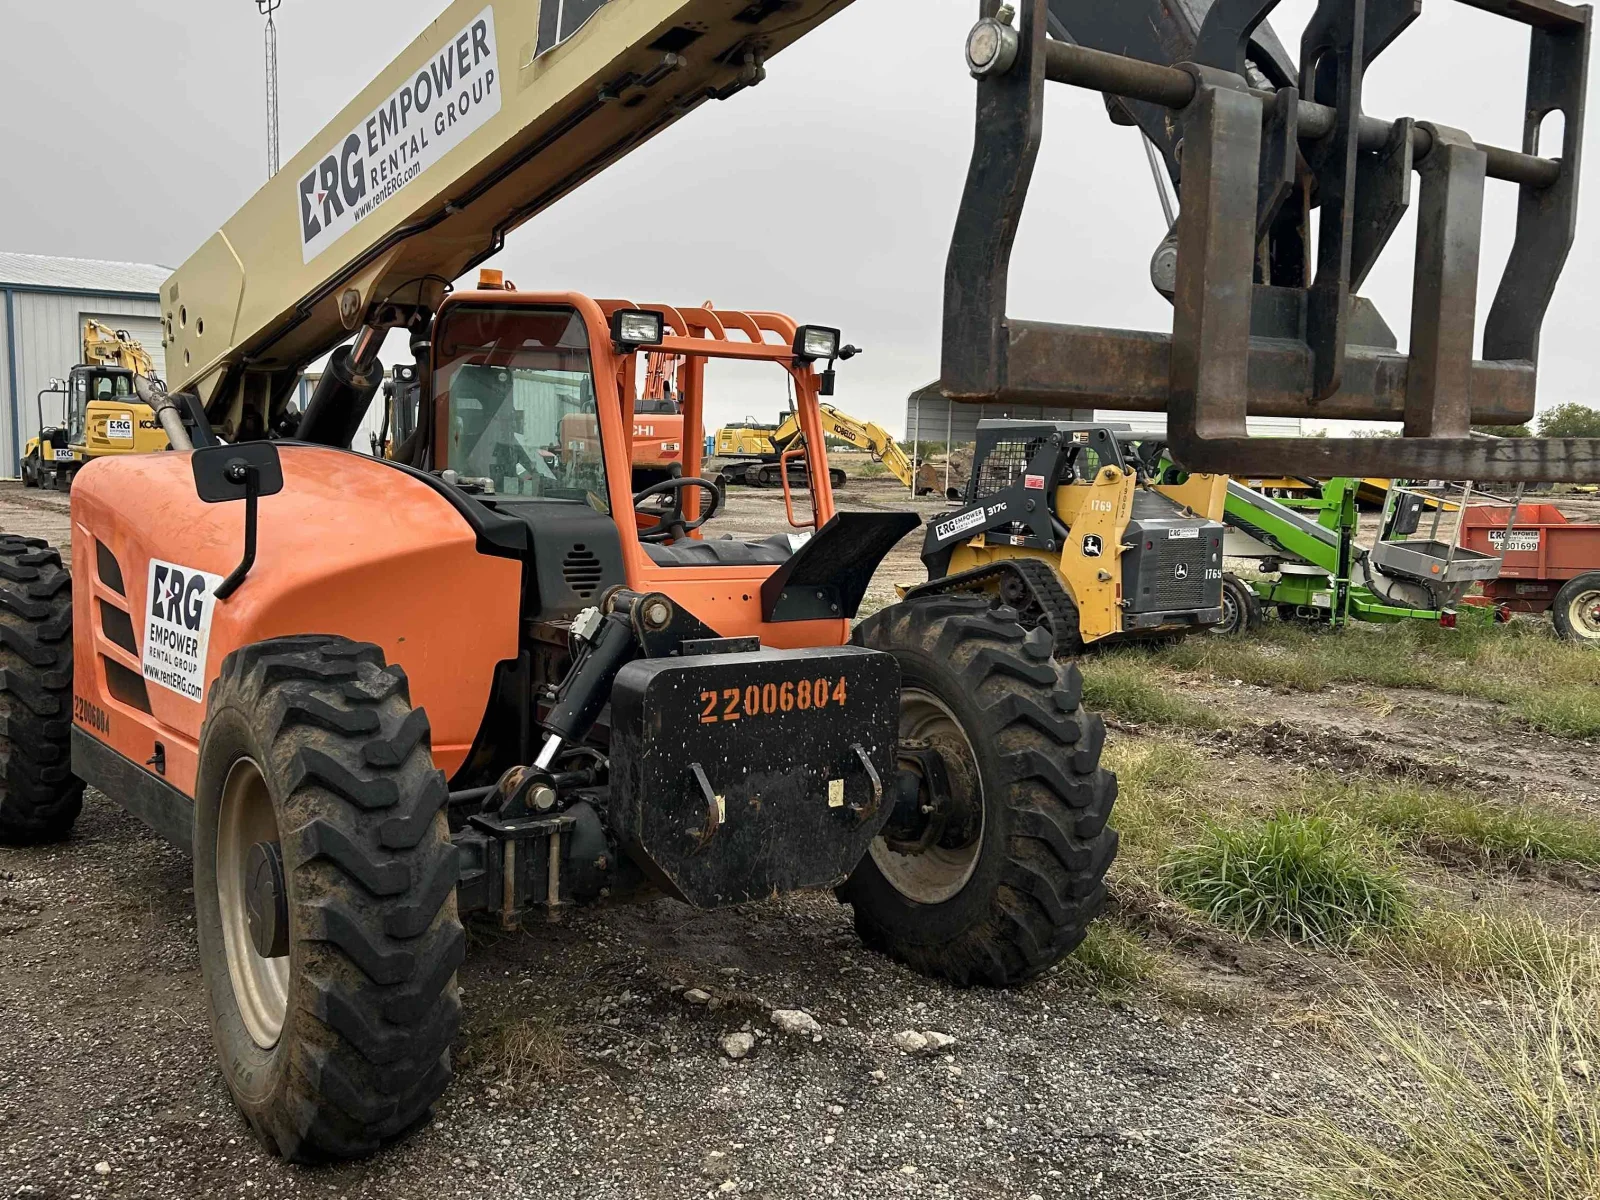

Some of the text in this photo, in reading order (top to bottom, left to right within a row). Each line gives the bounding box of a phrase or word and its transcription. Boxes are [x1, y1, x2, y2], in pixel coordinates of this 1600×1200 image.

[366, 19, 491, 158] EMPOWER
[370, 69, 494, 189] RENTAL GROUP
[300, 133, 366, 244] ERG
[353, 160, 421, 222] www.rentERG.com
[109, 420, 130, 429] ERG
[954, 509, 983, 525] EMPOWER
[986, 502, 1007, 516] 317G
[1091, 500, 1112, 512] 1769
[937, 520, 956, 537] ERG
[1205, 568, 1222, 579] 1769
[152, 564, 206, 631] ERG
[150, 623, 198, 658] EMPOWER
[149, 646, 198, 674] RENTAL GROUP
[144, 663, 202, 700] www.rentERG.com
[700, 676, 847, 723] 22006804
[75, 695, 110, 737] 22006804
